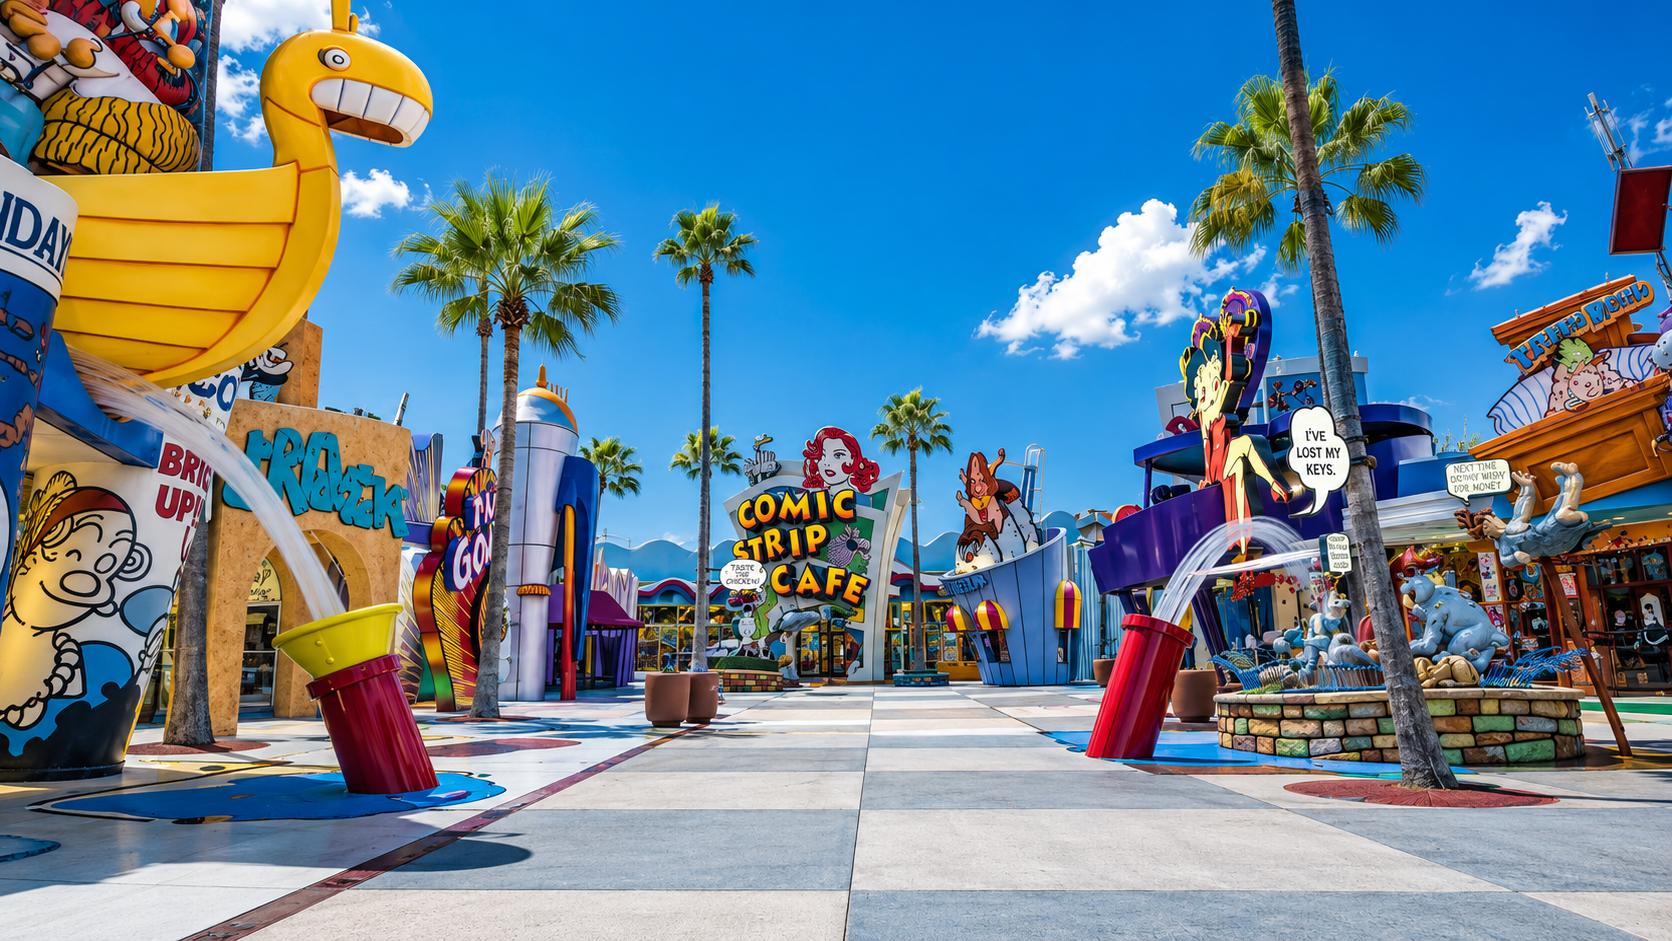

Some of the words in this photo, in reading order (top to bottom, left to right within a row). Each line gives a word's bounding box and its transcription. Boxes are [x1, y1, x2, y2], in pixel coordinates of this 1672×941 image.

[1305, 428, 1327, 441] I'VE
[1297, 447, 1322, 458] LOST
[1326, 447, 1341, 459] MY
[1306, 463, 1336, 475] KEYS.
[737, 489, 856, 530] COMIC
[732, 524, 829, 562] STRIP
[770, 563, 869, 606] CAFE
